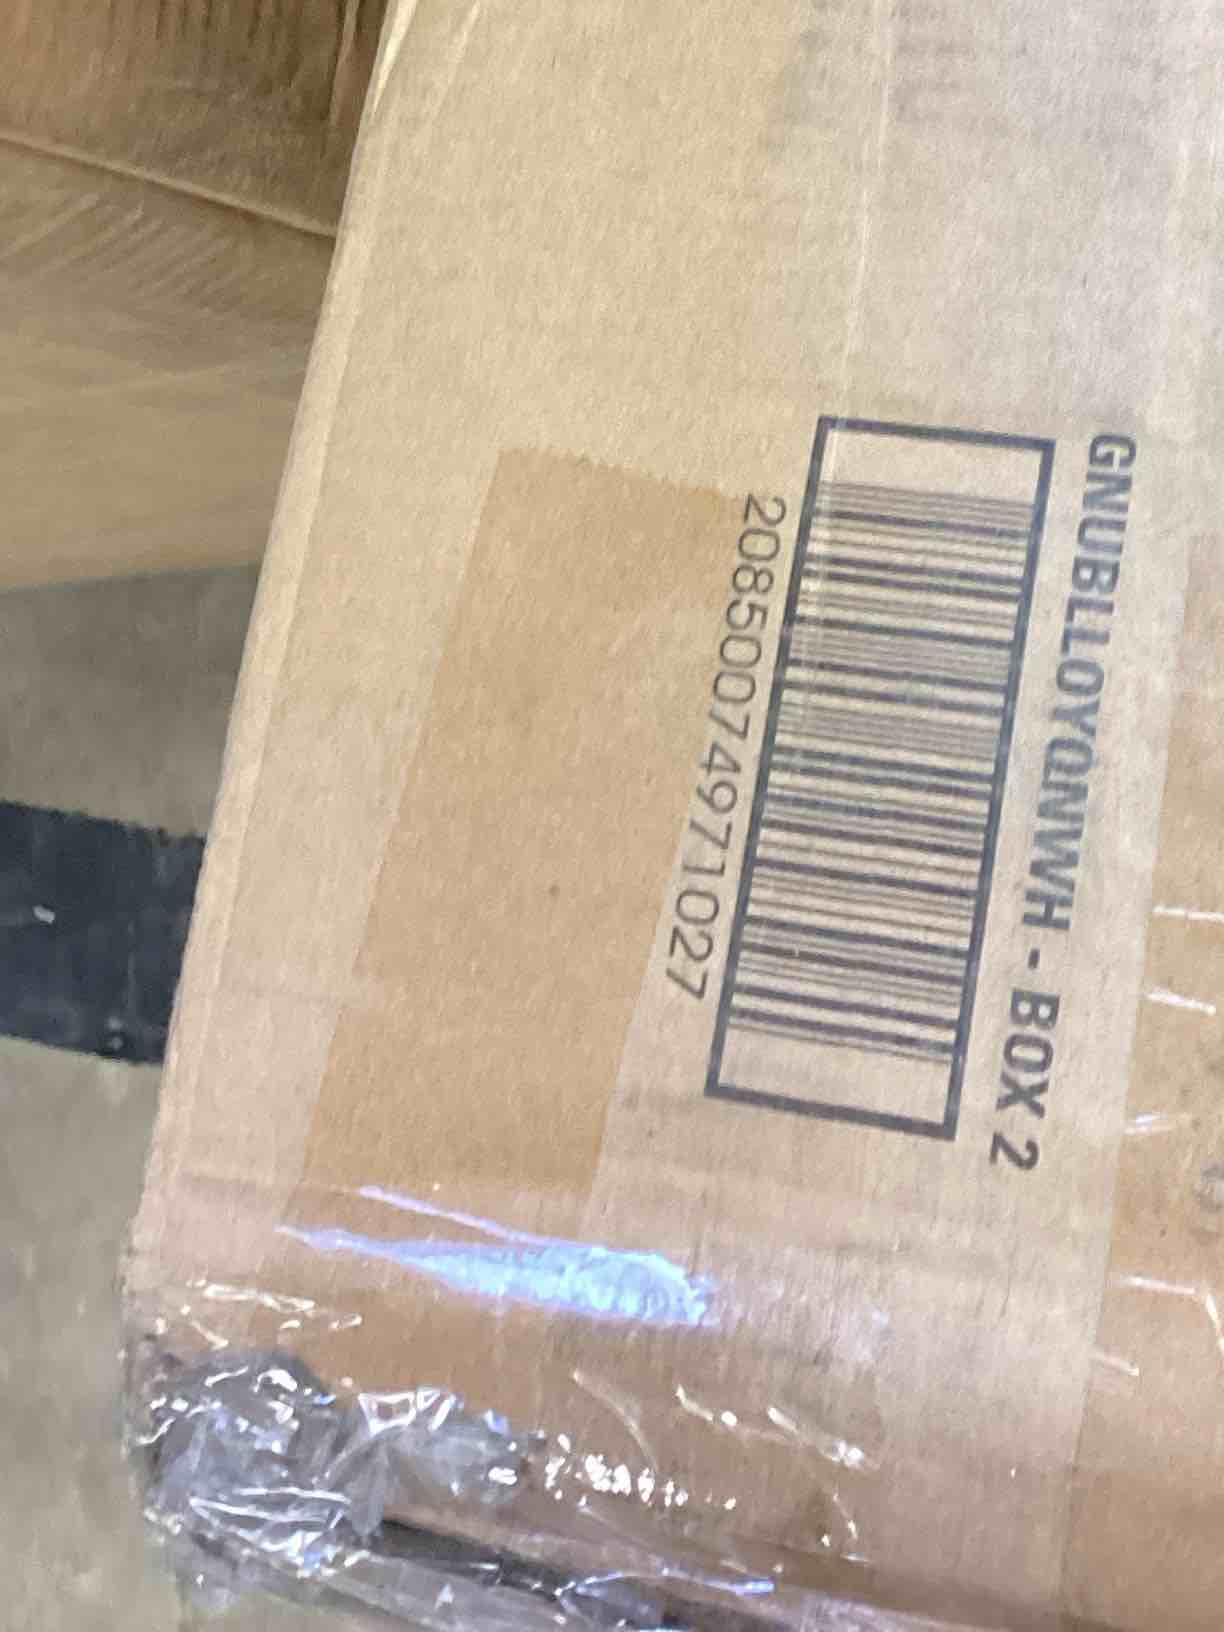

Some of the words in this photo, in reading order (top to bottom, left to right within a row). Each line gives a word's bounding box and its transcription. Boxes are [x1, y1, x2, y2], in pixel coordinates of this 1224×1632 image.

[665, 495, 786, 1001] 20850074971027
[1022, 433, 1137, 932] GNUBLLOYQNWH
[990, 1136, 1041, 1170] 2
[999, 988, 1061, 1121] BOX
